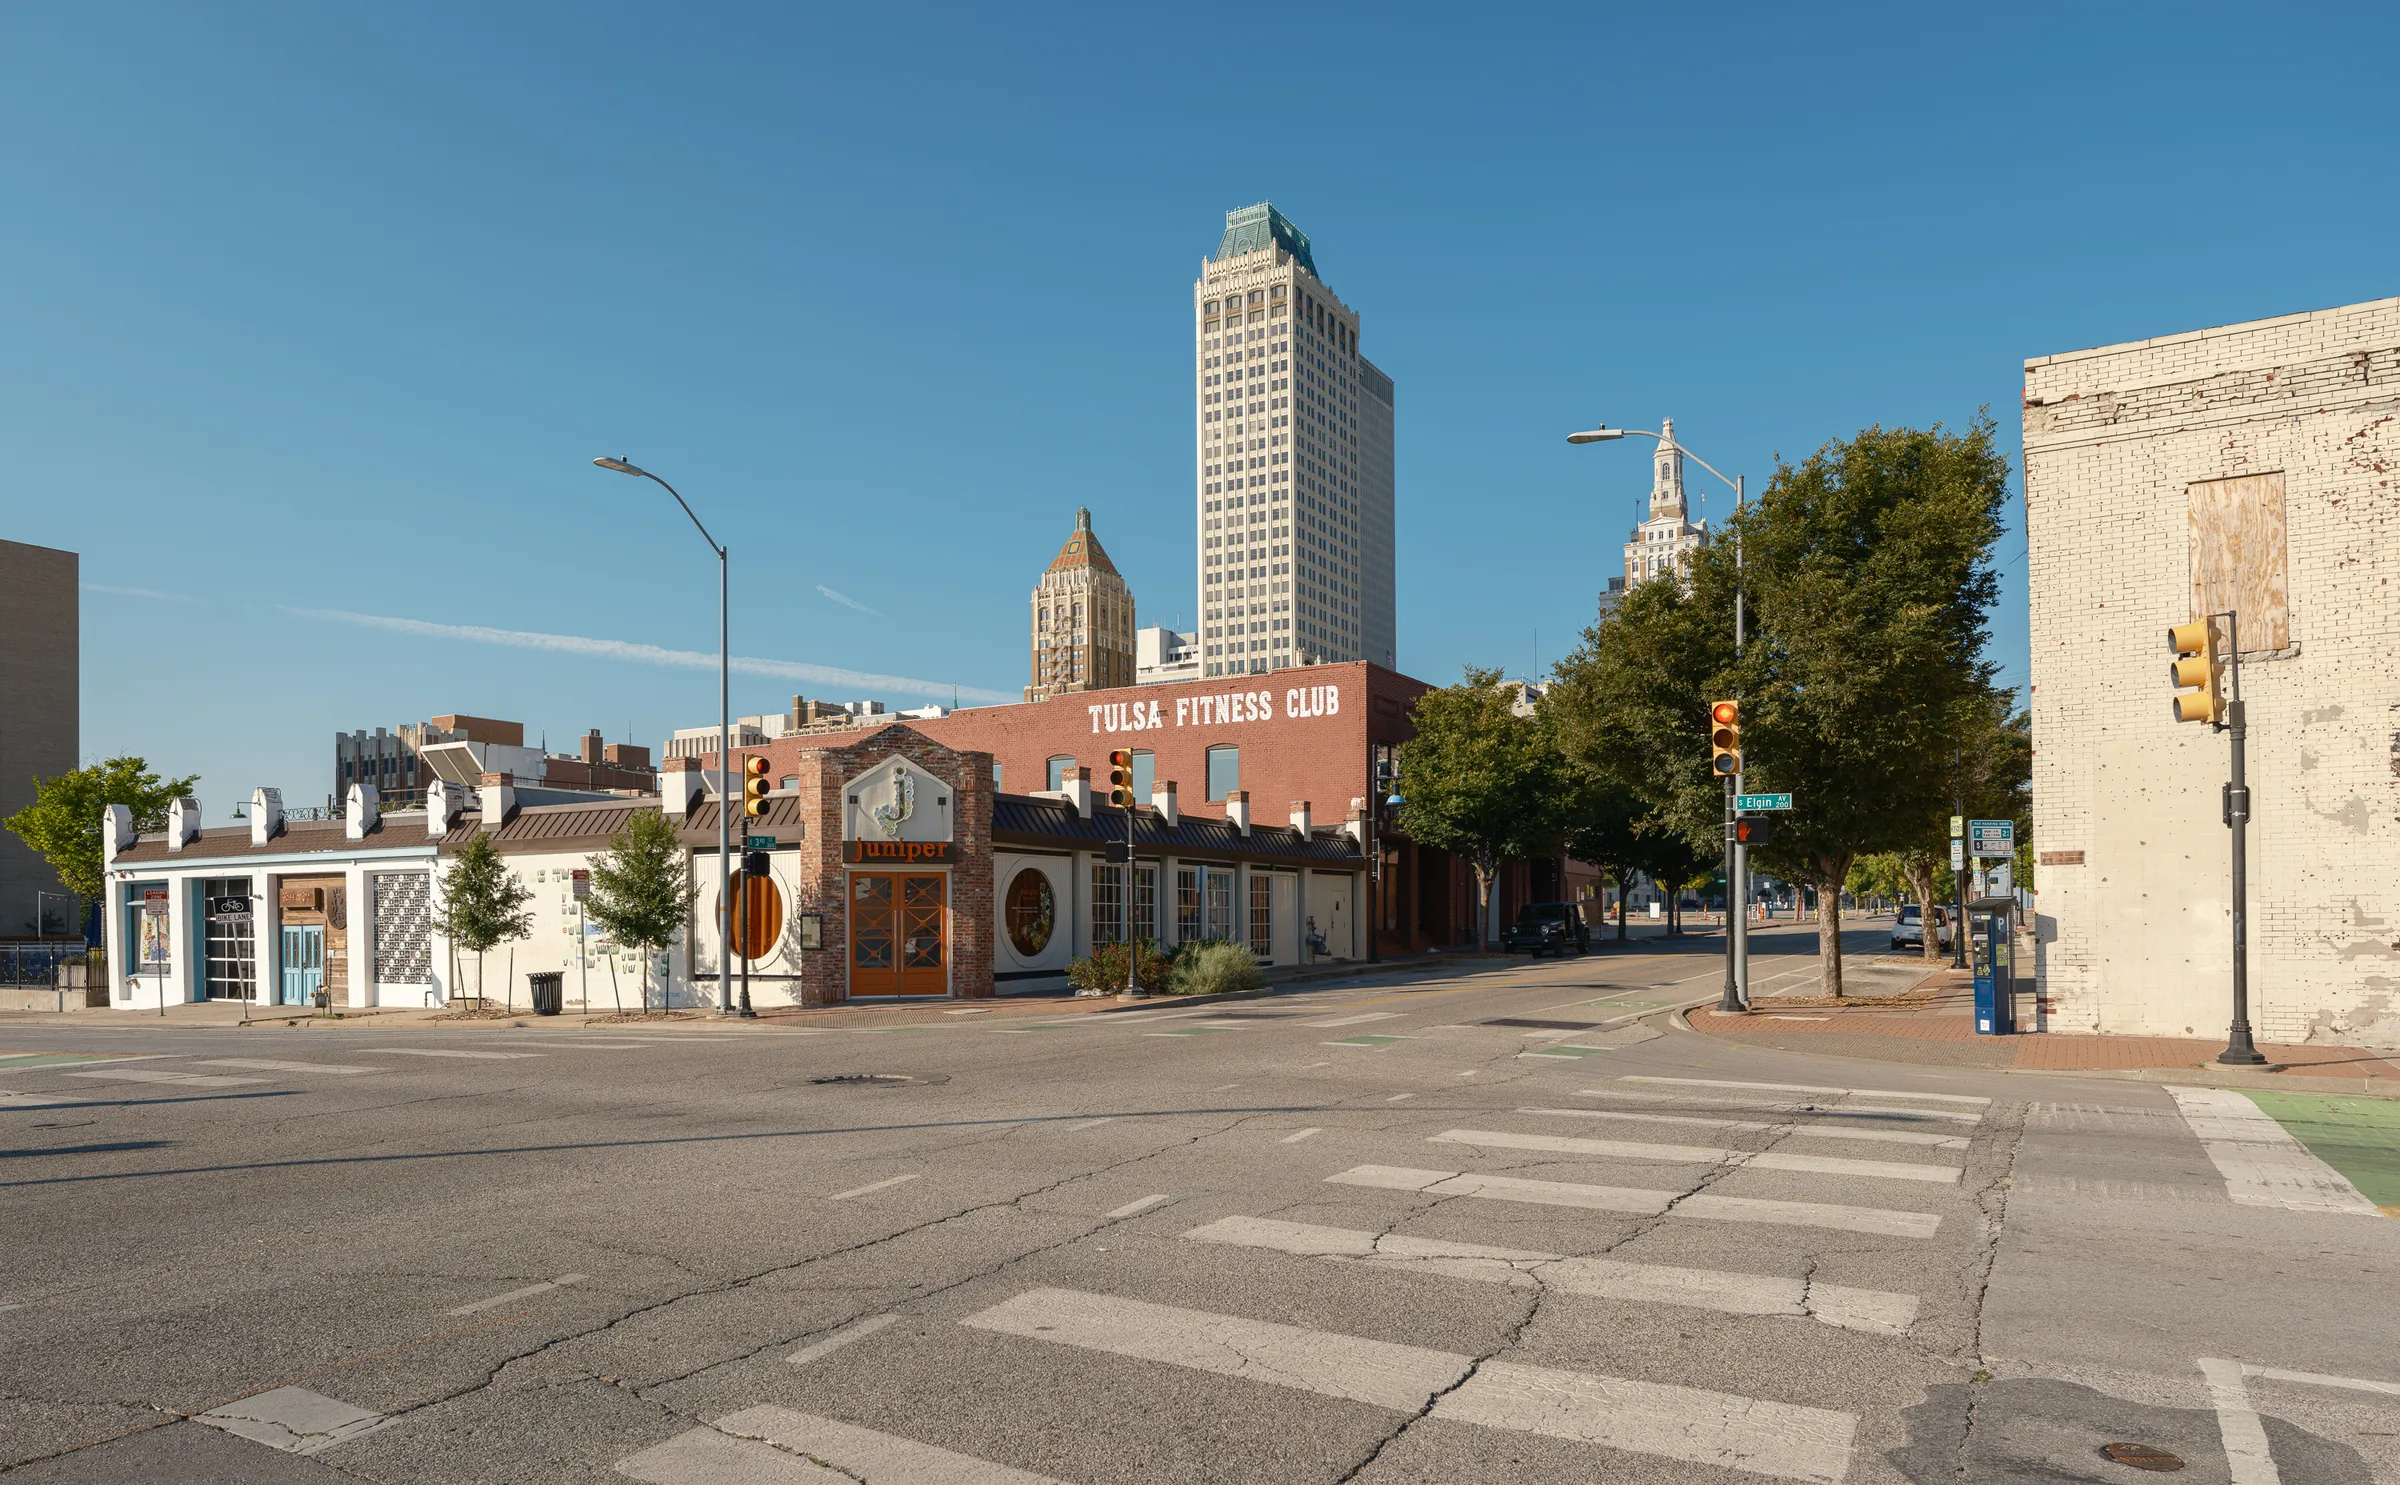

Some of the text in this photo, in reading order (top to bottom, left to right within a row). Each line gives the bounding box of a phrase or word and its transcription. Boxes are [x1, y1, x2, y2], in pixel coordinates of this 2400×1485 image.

[1089, 685, 1339, 733] TULSA FITNESS CLUB
[1746, 797, 1772, 809] Elgin
[852, 836, 948, 863] juniper
[217, 913, 250, 922] BIKE LANE
